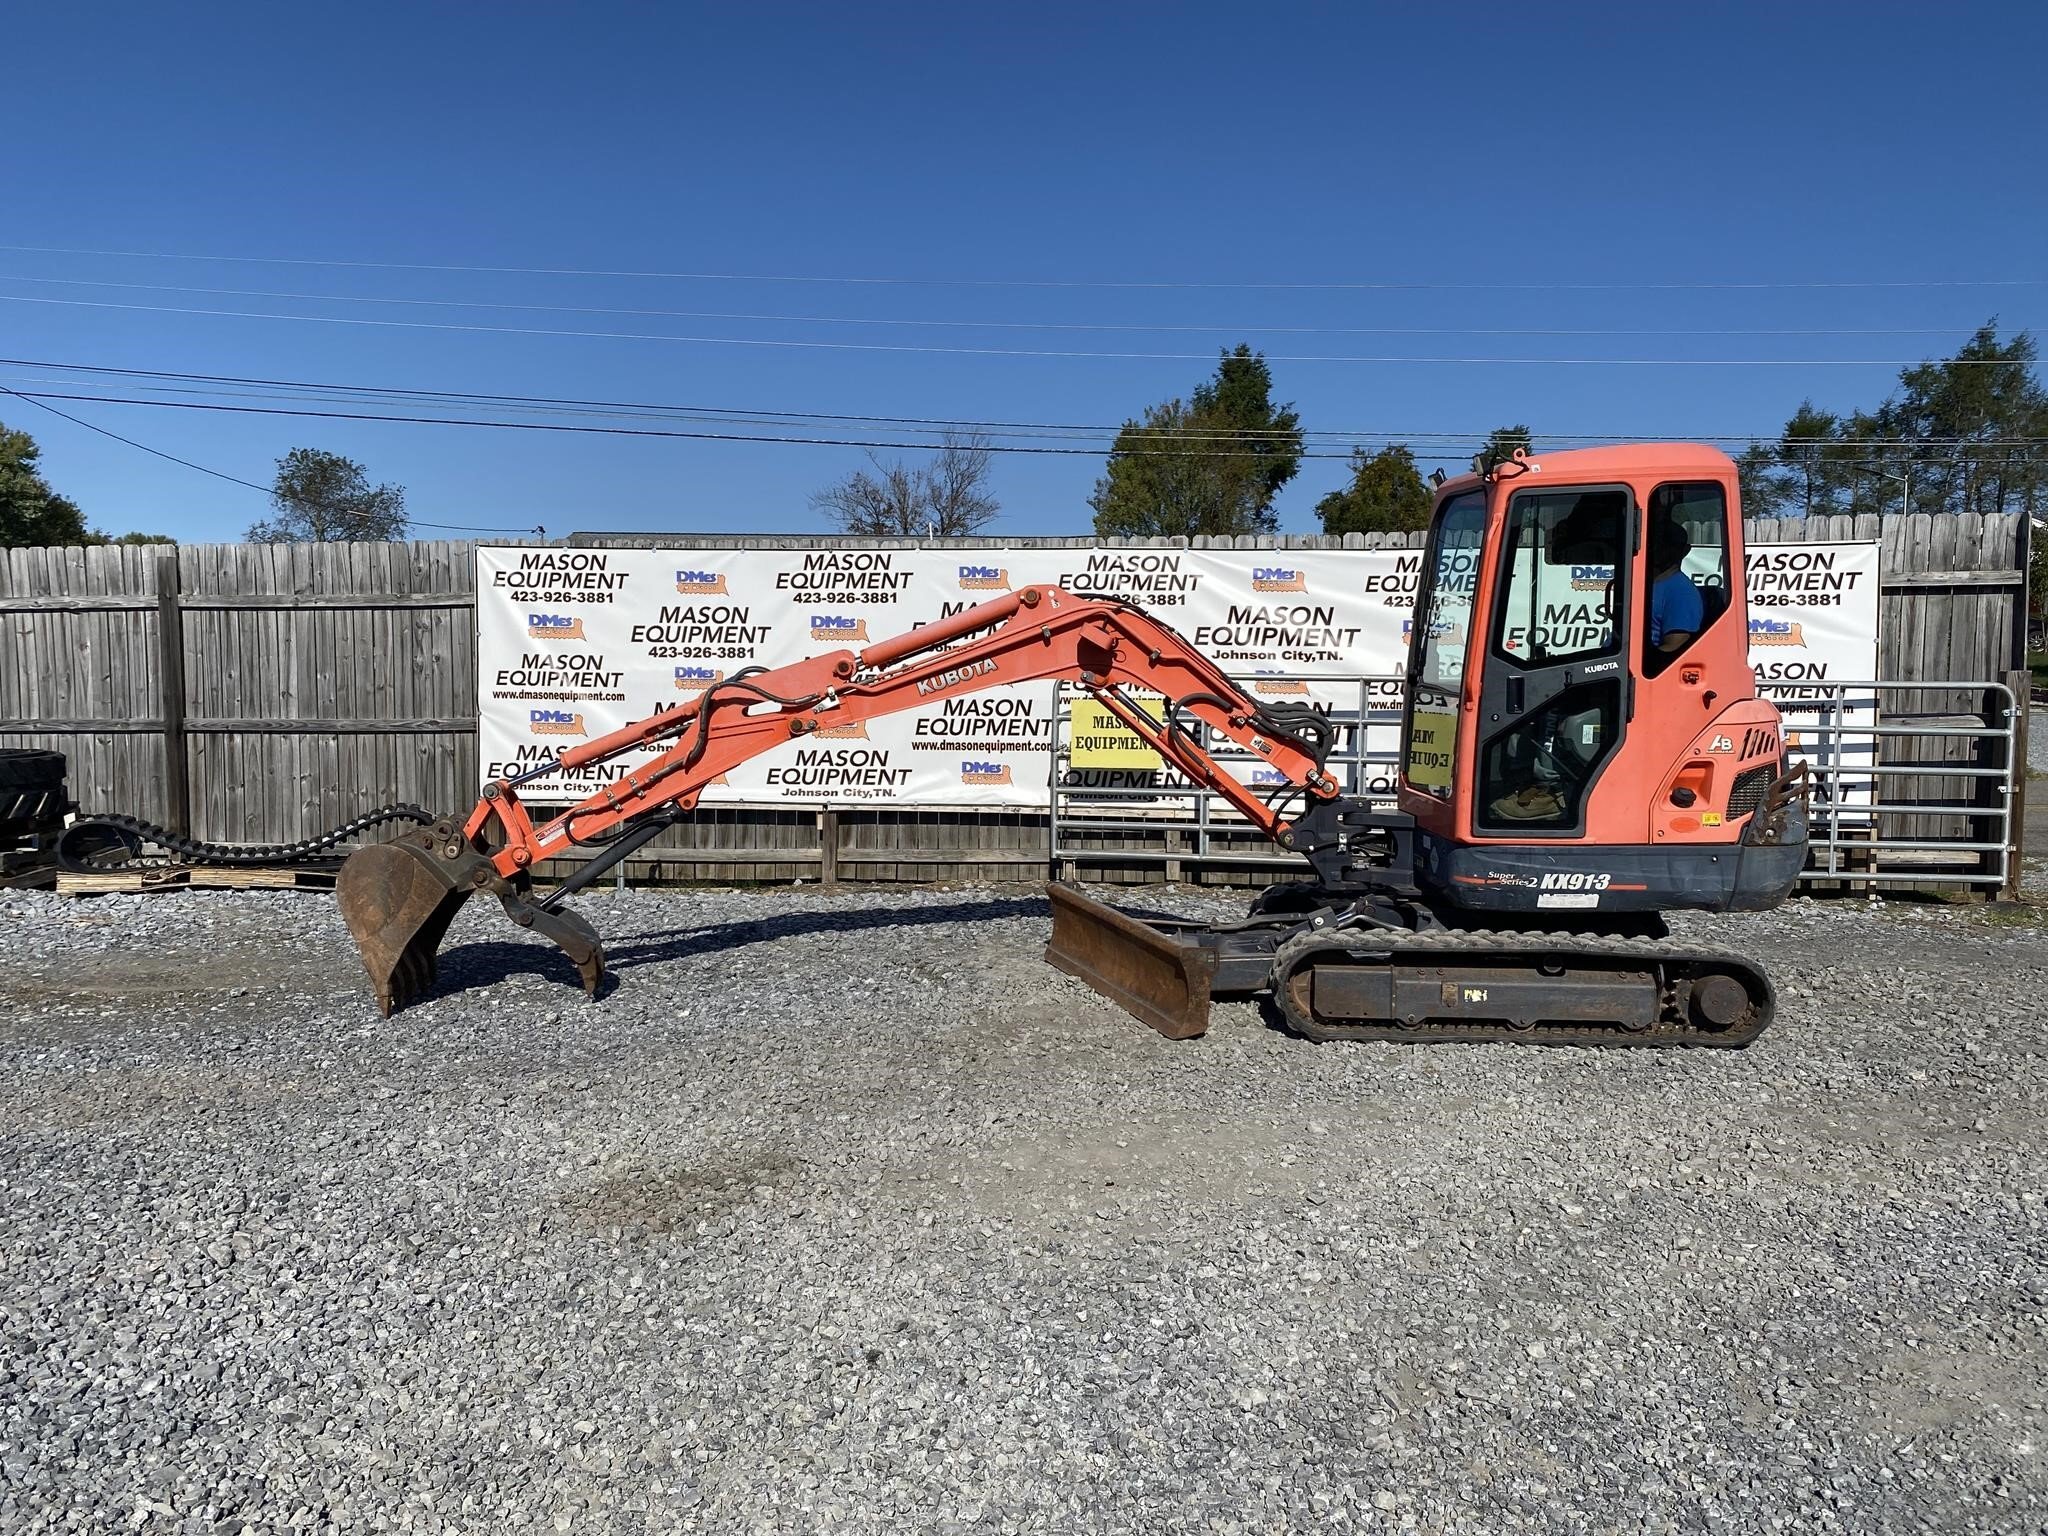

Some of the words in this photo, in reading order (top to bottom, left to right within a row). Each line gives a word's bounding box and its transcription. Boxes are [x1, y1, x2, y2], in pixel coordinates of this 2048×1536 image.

[520, 554, 607, 571] MASON
[803, 554, 891, 571] MASON
[1087, 555, 1180, 572] MASON
[493, 571, 629, 589] EQUIPMENT
[775, 572, 914, 589] EQUIPMENT
[1059, 574, 1204, 591] EQUIPMENT
[510, 591, 614, 603] 423-926-3881
[793, 592, 897, 604] 423-926-3881
[659, 606, 749, 624] MASON
[1227, 605, 1334, 626] MASON
[631, 625, 771, 644] EQUIPMENT
[1194, 627, 1361, 648] EQUIPMENT
[521, 653, 603, 670] MASON
[648, 647, 755, 659] 423-926-3881
[1211, 650, 1276, 660] Johnson
[1584, 661, 1619, 674] KUBOTA
[1755, 663, 1828, 680] ASON
[496, 671, 624, 688] EQUIPMENT
[917, 658, 998, 696] KUBOTA
[492, 689, 625, 702] www.dmasonequipment.com
[943, 699, 1032, 717] MASON
[915, 719, 1052, 737] EQUIPMENT
[1075, 736, 1153, 752] EQUIPMEN
[795, 749, 889, 767] MASON
[766, 768, 912, 786] EQUIPMENT
[511, 783, 559, 791] ohnson
[781, 788, 838, 797] Johnson
[1487, 871, 1515, 880] Super
[1540, 873, 1611, 890] KX91-3
